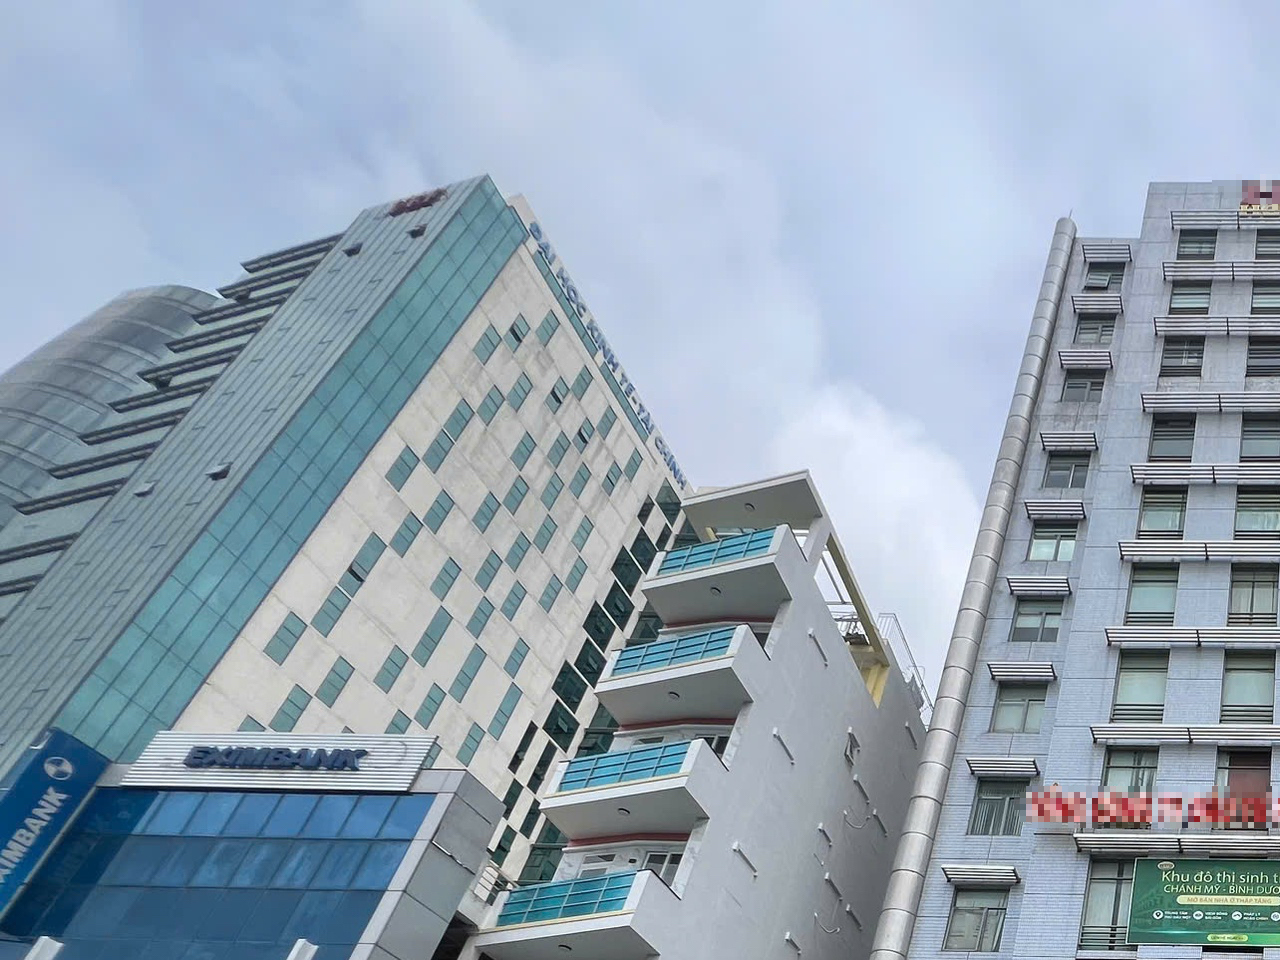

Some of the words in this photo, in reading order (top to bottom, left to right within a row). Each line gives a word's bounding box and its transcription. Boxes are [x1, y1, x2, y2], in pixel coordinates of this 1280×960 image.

[586, 318, 620, 373] KINH
[183, 746, 369, 771] EXIMBANK
[0, 786, 72, 883] XIMBANK
[1162, 871, 1189, 883] Khu
[1239, 872, 1268, 884] sinh
[1163, 884, 1201, 893] CHÁNH
[1229, 884, 1253, 894] BÌNH
